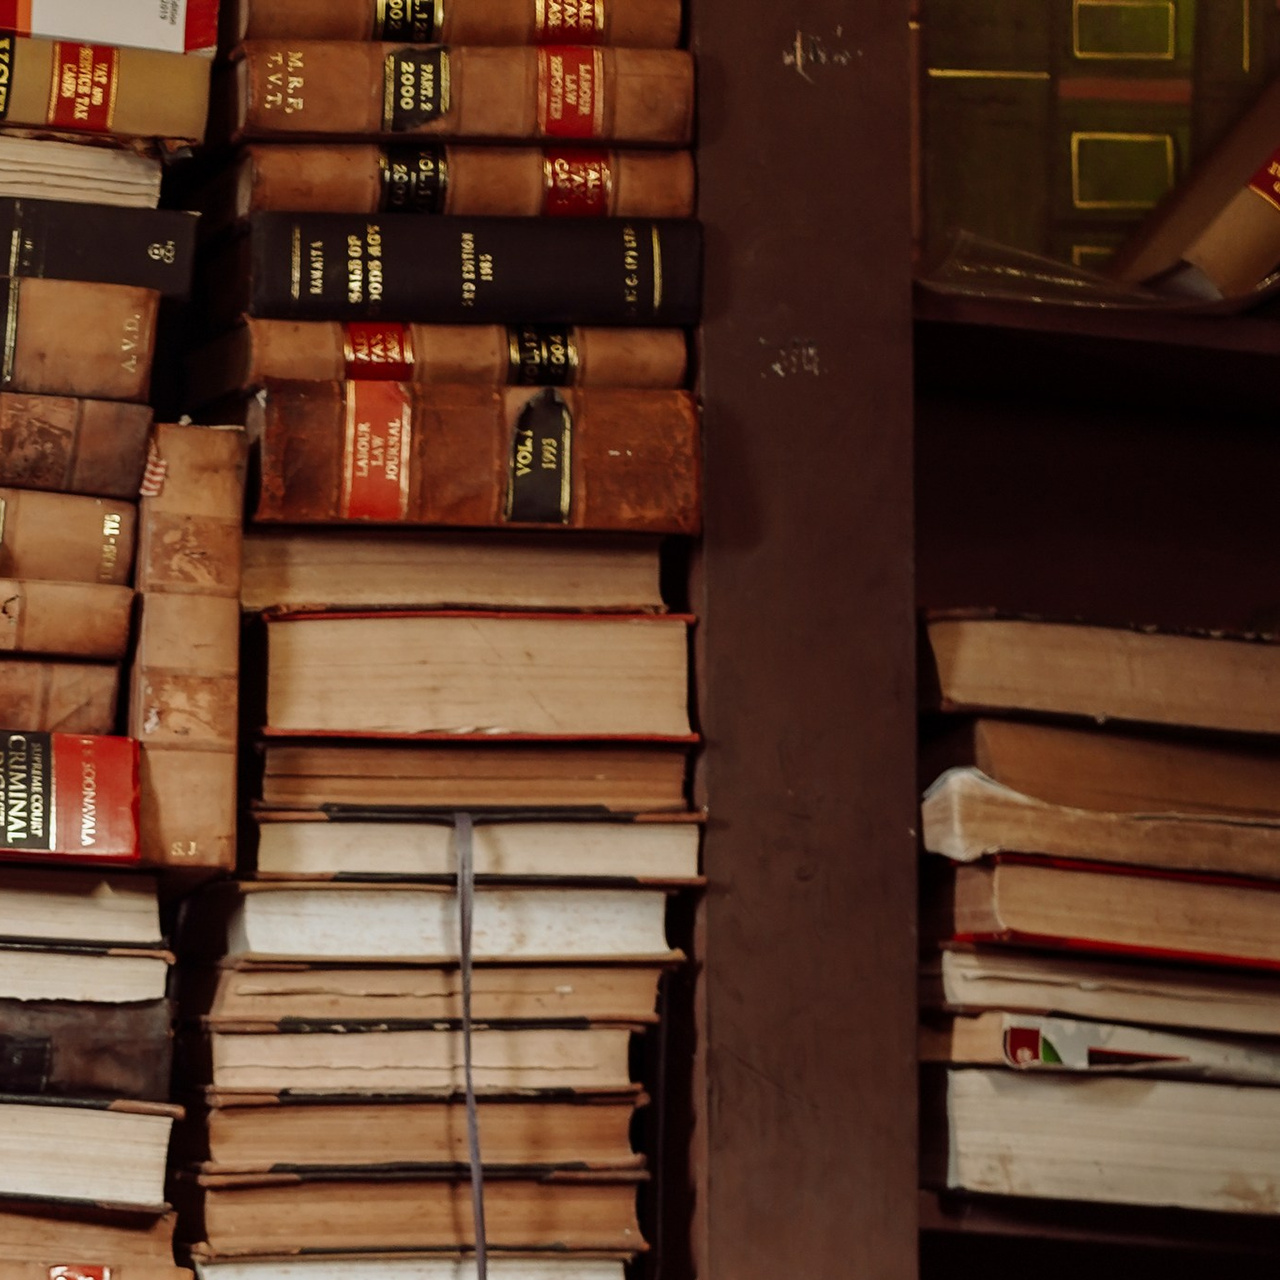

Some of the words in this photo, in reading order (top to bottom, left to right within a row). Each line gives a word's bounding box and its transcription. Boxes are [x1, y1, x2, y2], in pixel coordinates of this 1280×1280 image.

[74, 97, 89, 120] TAX
[400, 60, 416, 110] 2000
[564, 73, 577, 105] LAW
[578, 63, 592, 116] LABOUR
[356, 421, 370, 478] LABOUR
[371, 435, 385, 467] LAW
[384, 418, 401, 480] JOURNAL
[7, 734, 28, 844] CRIMINAL
[30, 742, 43, 794] SUPREME
[30, 793, 44, 838] COURT
